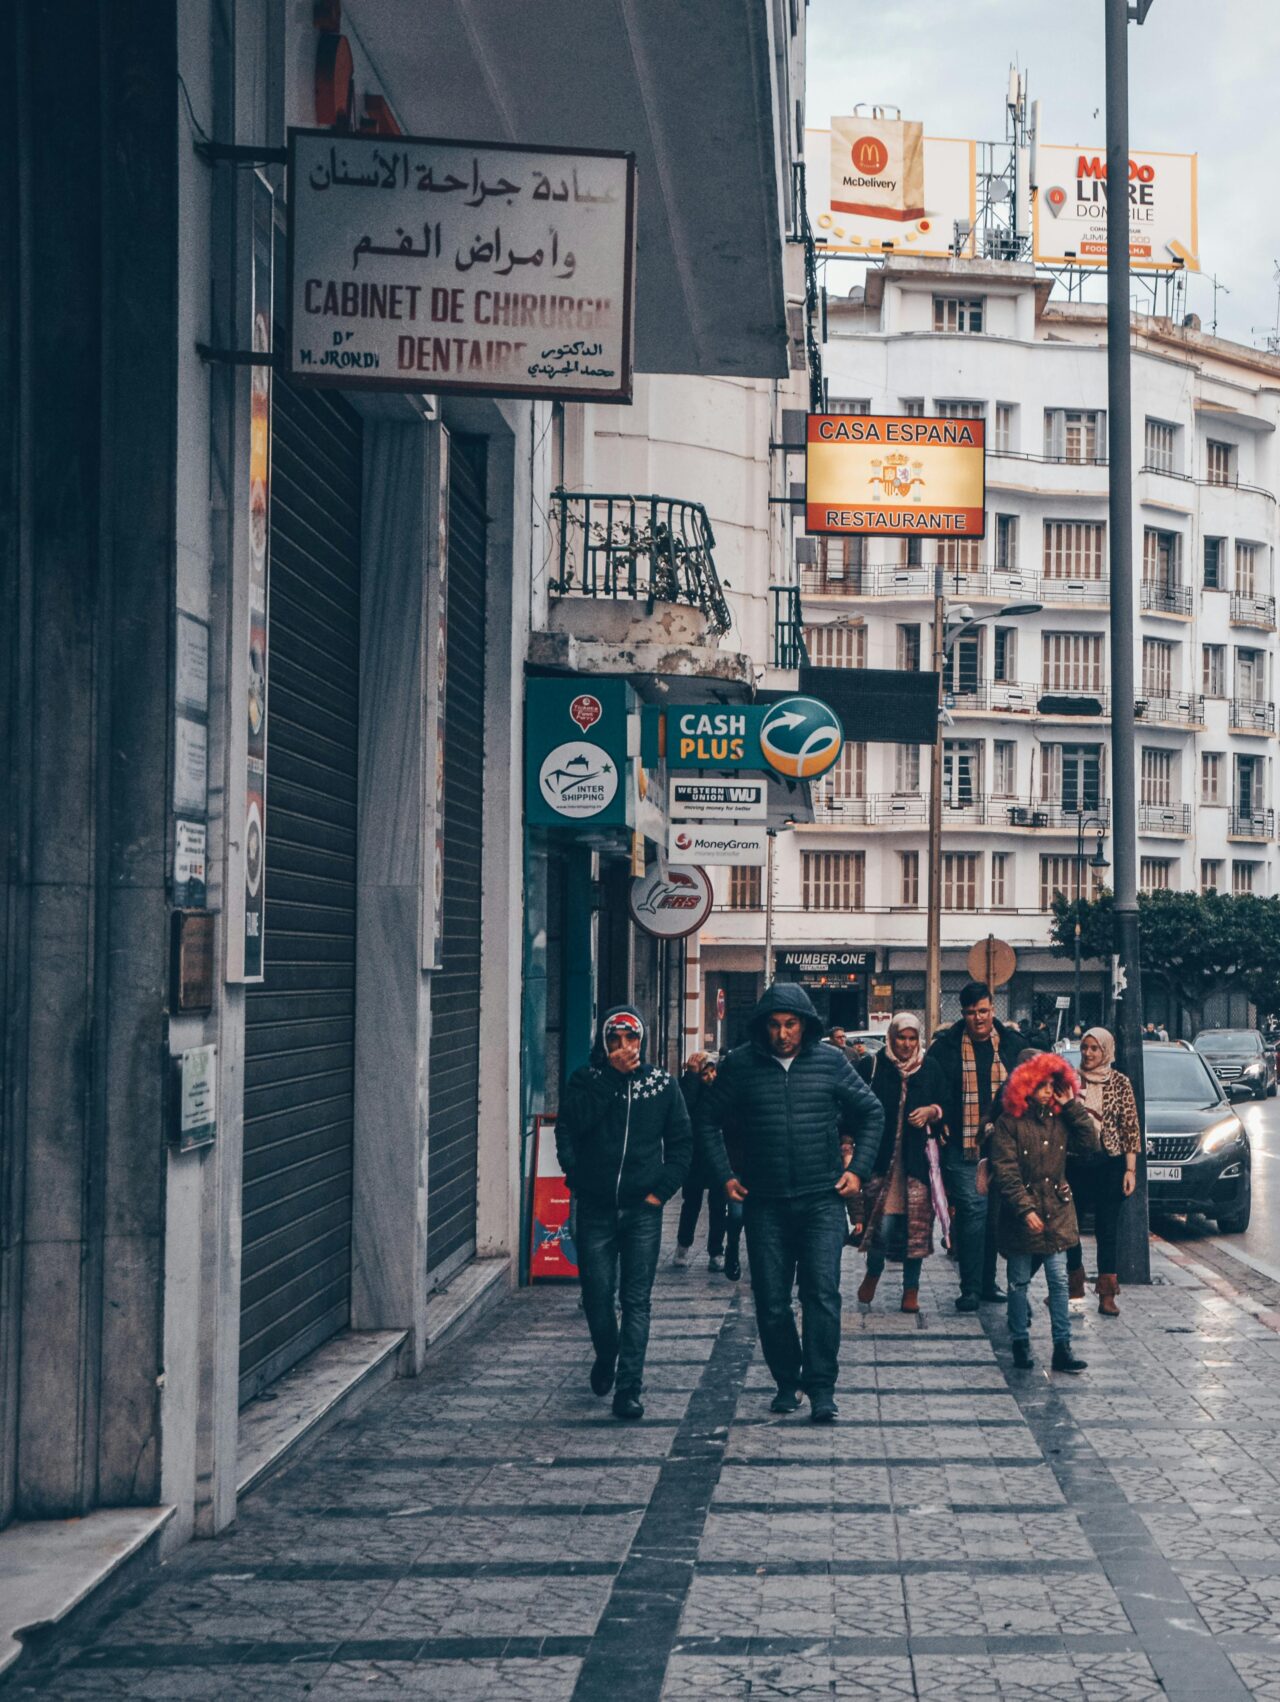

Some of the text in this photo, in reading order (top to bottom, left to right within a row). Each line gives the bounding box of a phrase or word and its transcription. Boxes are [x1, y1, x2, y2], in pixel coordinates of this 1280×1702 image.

[309, 147, 619, 211] عيادة جراحة الأسنان
[843, 176, 896, 191] McDelivery
[1077, 204, 1154, 221] DOILE
[352, 222, 577, 279] وأمراض الفم
[305, 279, 422, 321] CABINET
[431, 287, 465, 324] DE
[541, 342, 603, 360] الدكتور
[579, 363, 615, 377] محمد
[819, 420, 974, 445] CASA ESPAÑA
[826, 510, 966, 530] RESTAURANTE
[680, 714, 745, 736] CASH
[680, 738, 744, 760] PLUS
[578, 785, 604, 793] INTER
[730, 787, 757, 802] WU
[694, 838, 759, 850] MoneyGram
[785, 953, 866, 964] NUMBER-ONE
[1169, 1169, 1179, 1178] 40
